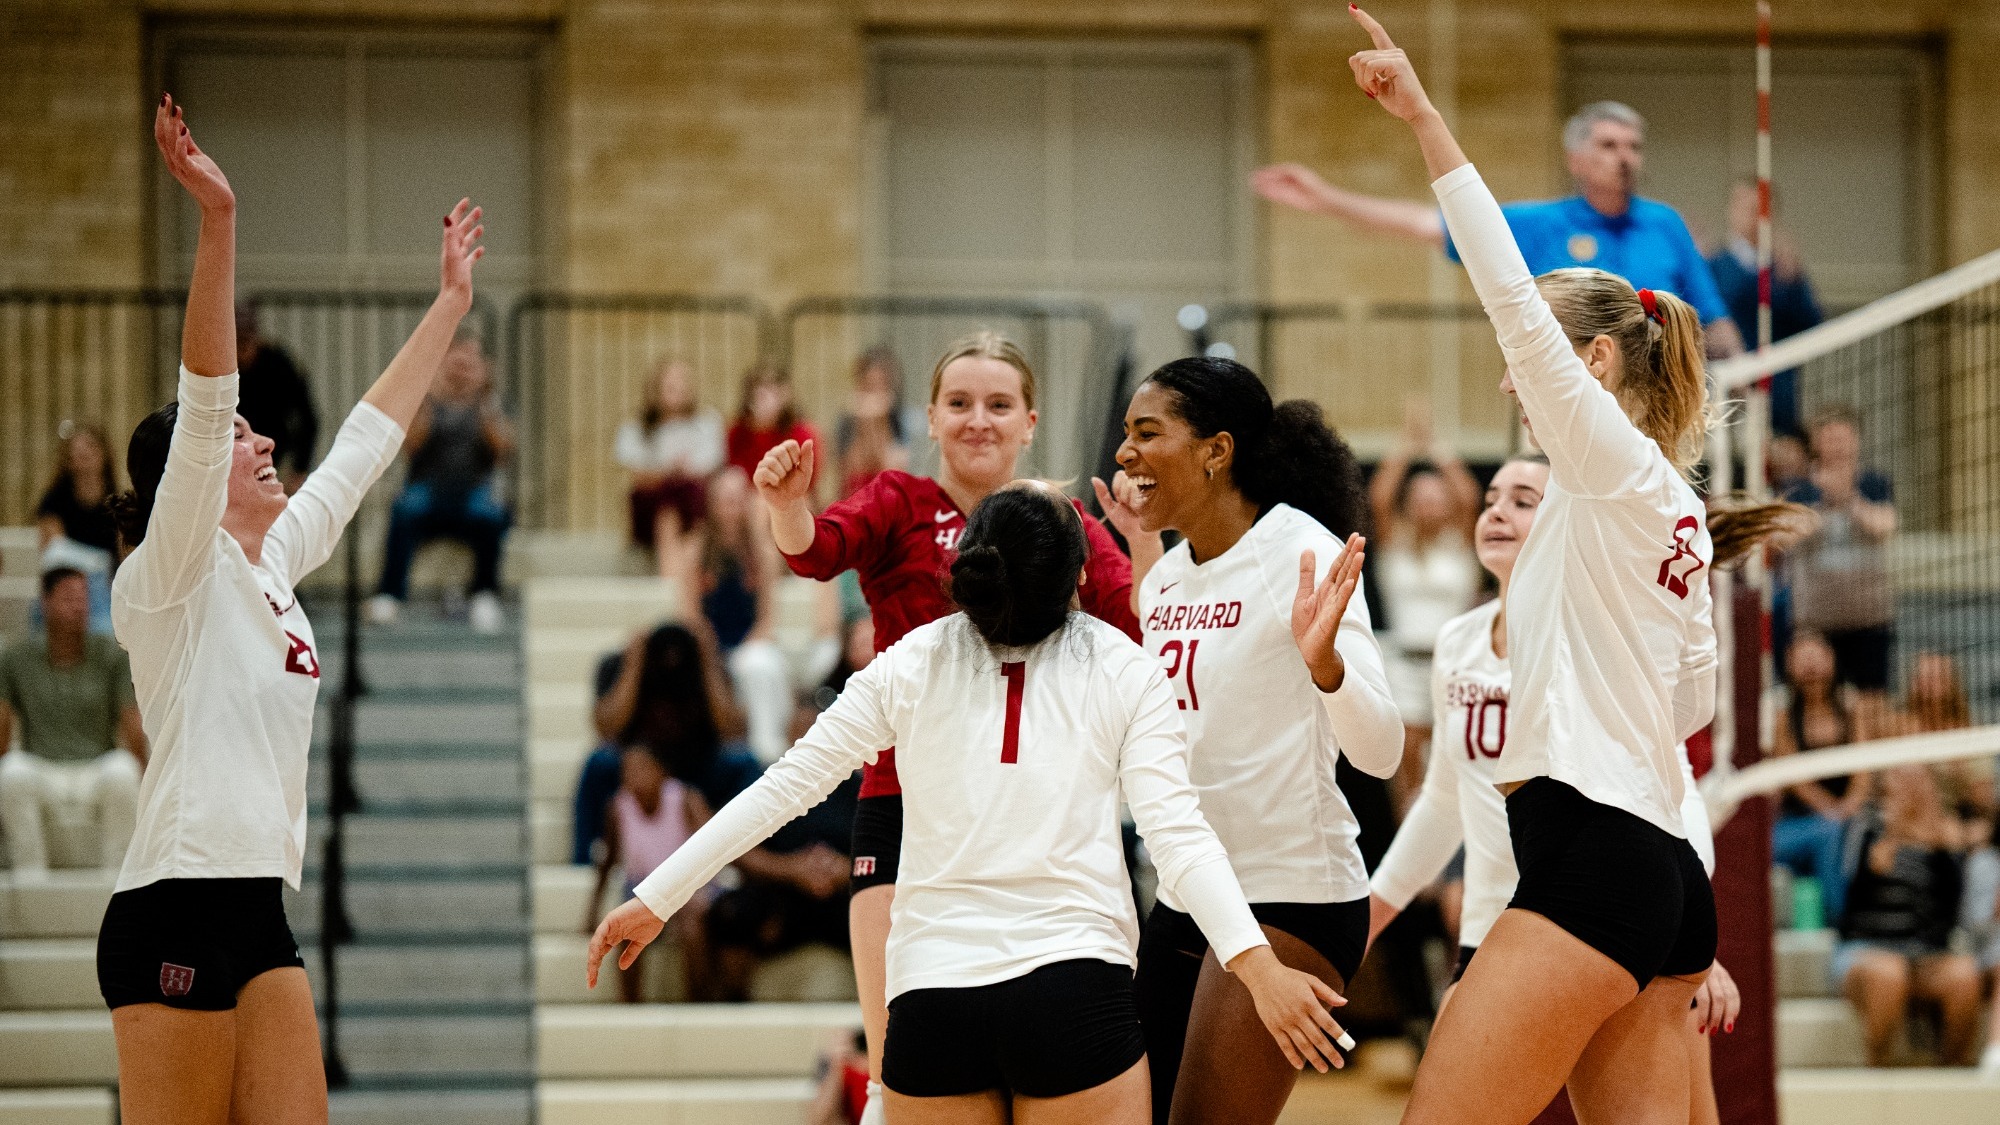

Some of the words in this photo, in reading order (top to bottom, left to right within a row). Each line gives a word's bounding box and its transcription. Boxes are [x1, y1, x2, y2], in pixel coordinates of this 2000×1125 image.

[1146, 601, 1242, 631] HARVARD
[1159, 639, 1200, 711] 21
[1000, 660, 1026, 764] 1
[1464, 698, 1508, 761] 10
